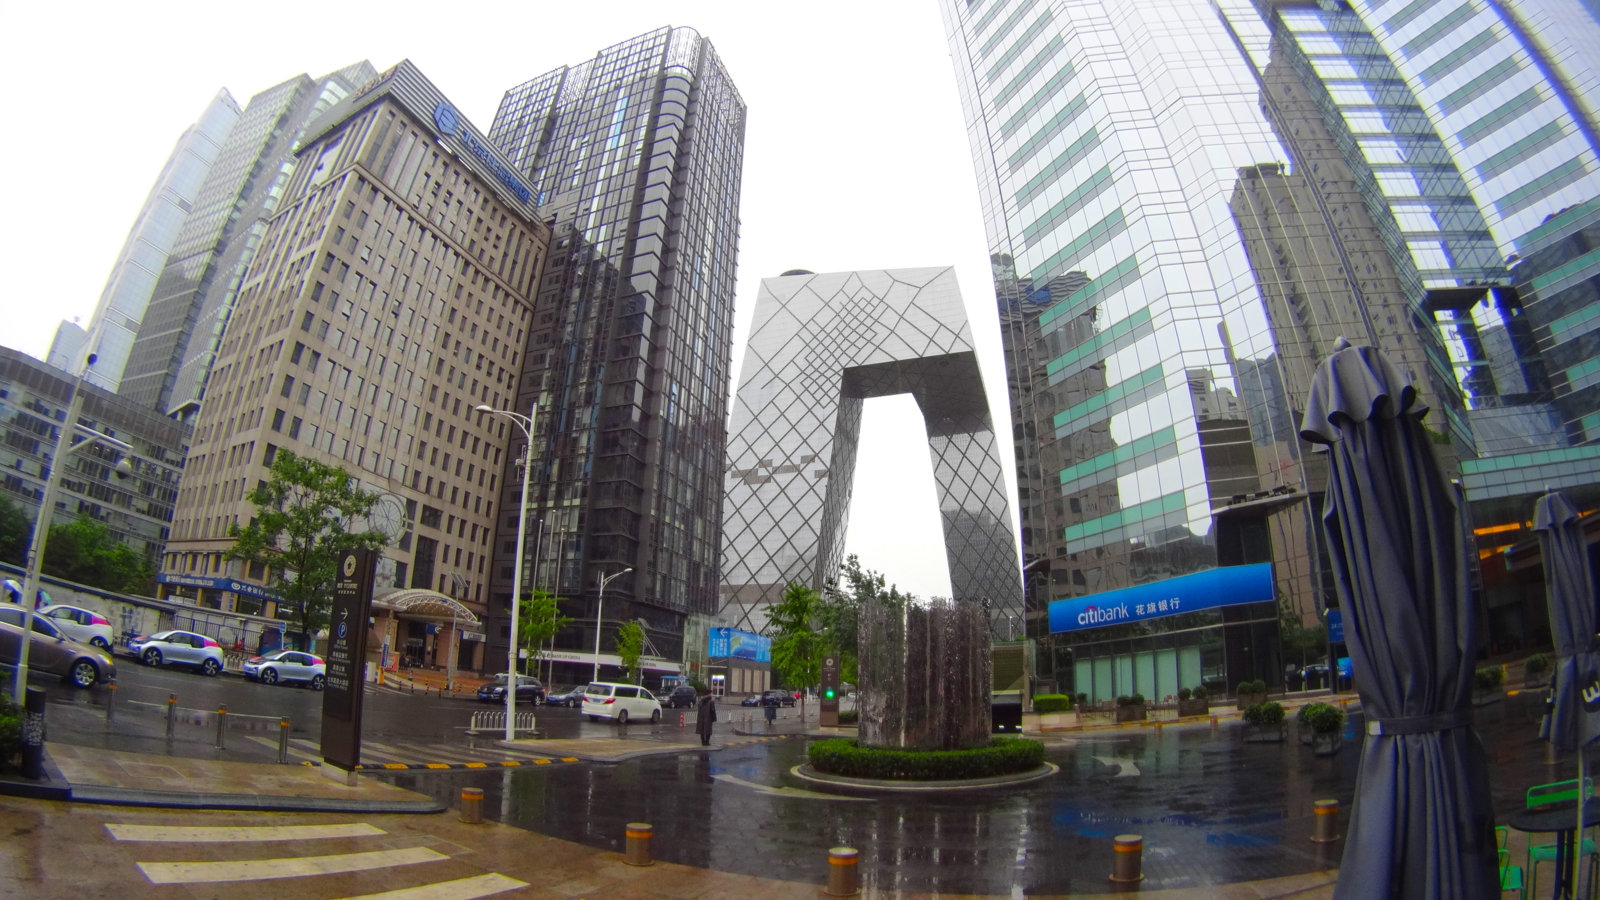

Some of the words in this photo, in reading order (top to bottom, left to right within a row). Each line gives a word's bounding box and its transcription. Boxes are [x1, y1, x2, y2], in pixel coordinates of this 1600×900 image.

[1078, 603, 1129, 625] citibank
[1135, 597, 1180, 616] 花旗银行
